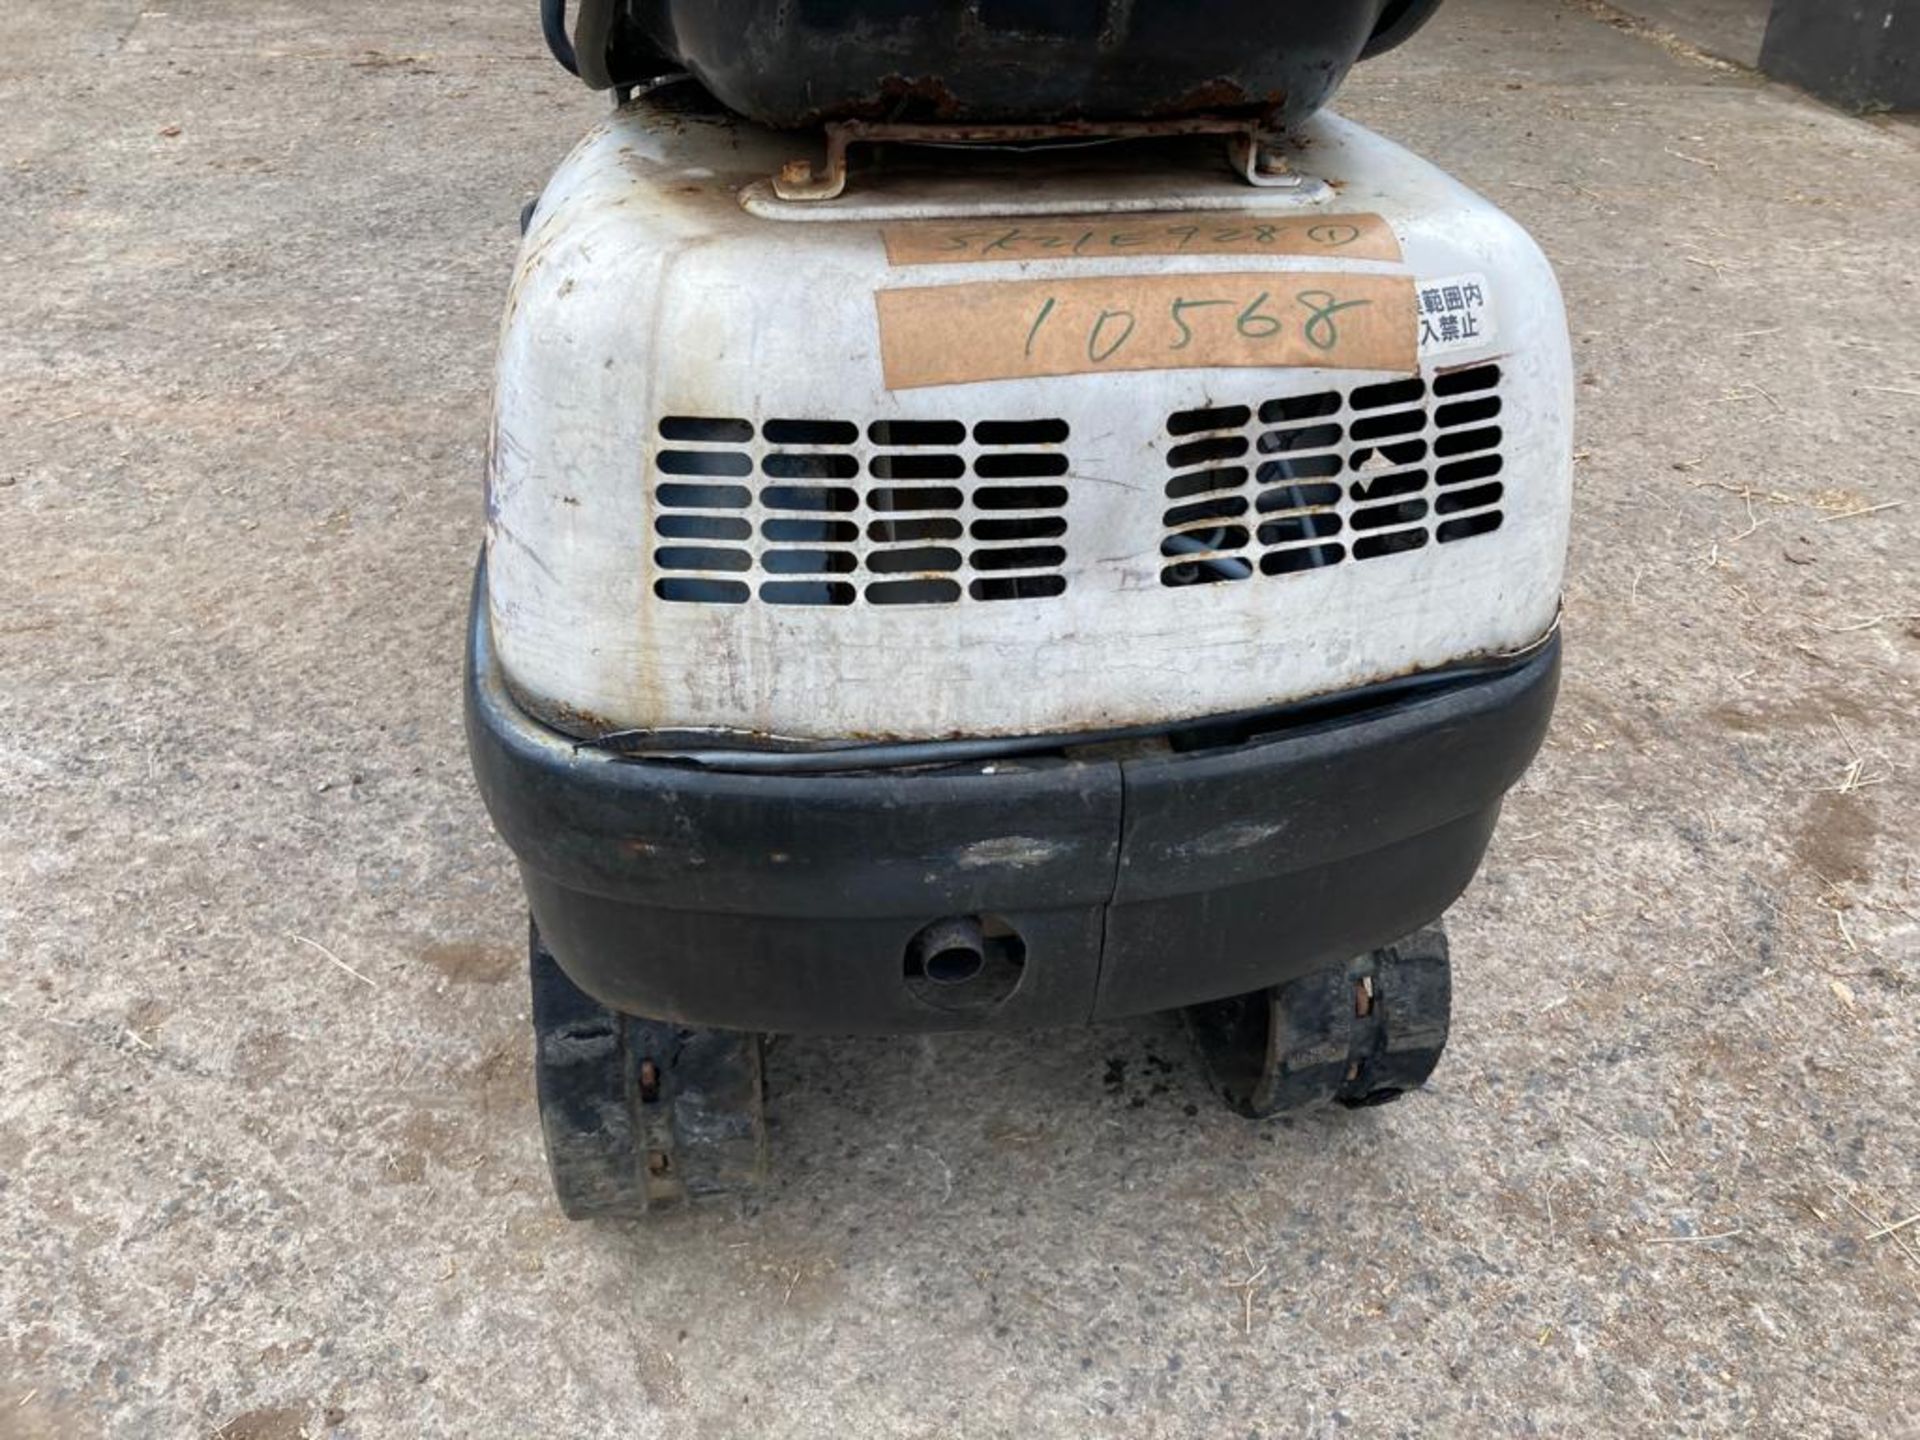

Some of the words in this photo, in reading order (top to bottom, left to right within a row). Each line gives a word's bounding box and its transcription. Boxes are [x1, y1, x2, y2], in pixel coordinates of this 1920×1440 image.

[1416, 282, 1484, 315] 範囲内
[1024, 290, 1374, 363] 10568
[1420, 311, 1480, 346] 入禁止
